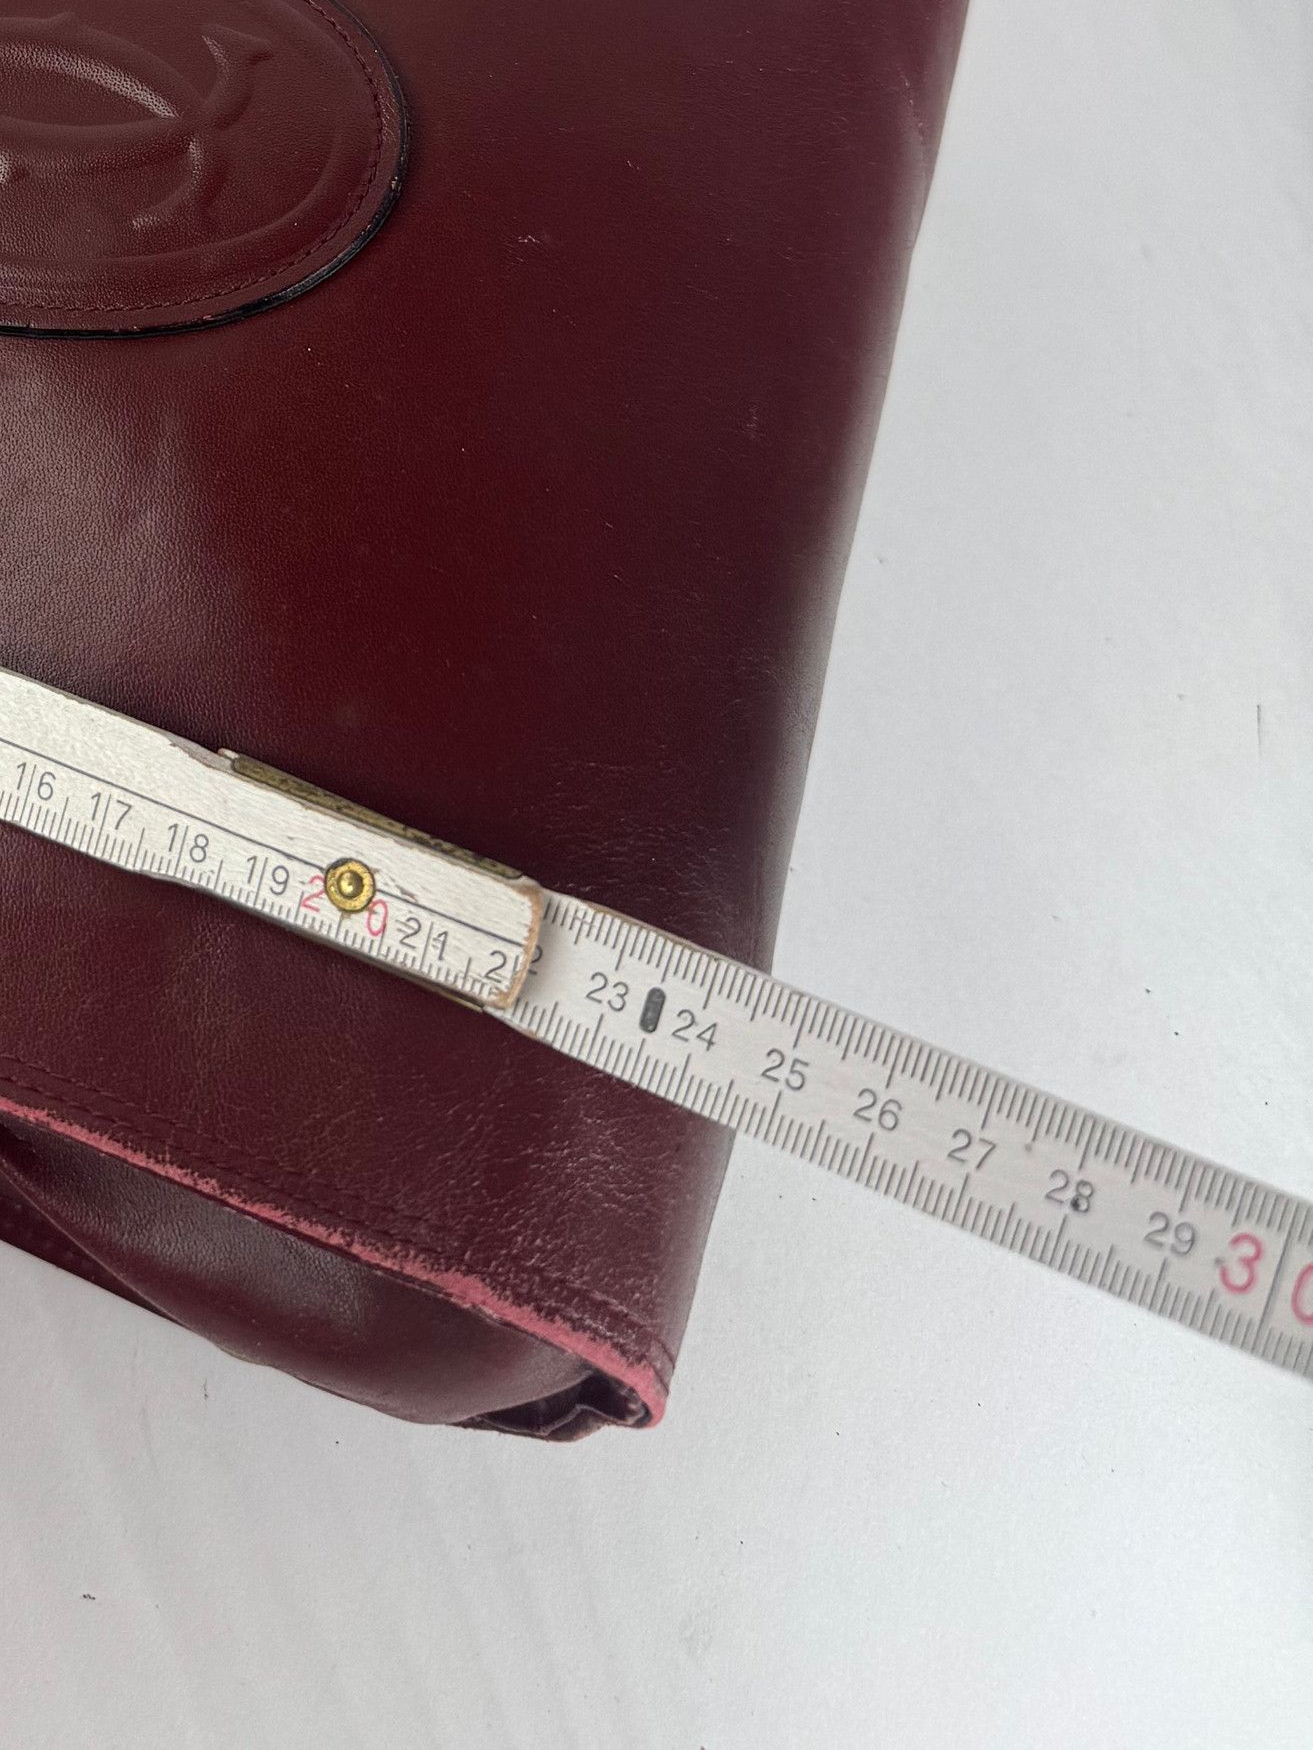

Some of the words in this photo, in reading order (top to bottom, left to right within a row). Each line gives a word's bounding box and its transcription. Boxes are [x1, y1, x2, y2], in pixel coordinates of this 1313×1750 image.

[16, 761, 57, 801] 16
[91, 791, 132, 830] 17
[167, 823, 209, 863] 18
[246, 855, 290, 896] 19
[399, 916, 449, 961] 21
[585, 971, 630, 1012] 23
[671, 1009, 719, 1051] 24
[760, 1047, 810, 1091] 25
[853, 1087, 903, 1131] 26
[947, 1128, 997, 1171] 27
[1044, 1168, 1095, 1214] 28
[1143, 1211, 1196, 1257] 29
